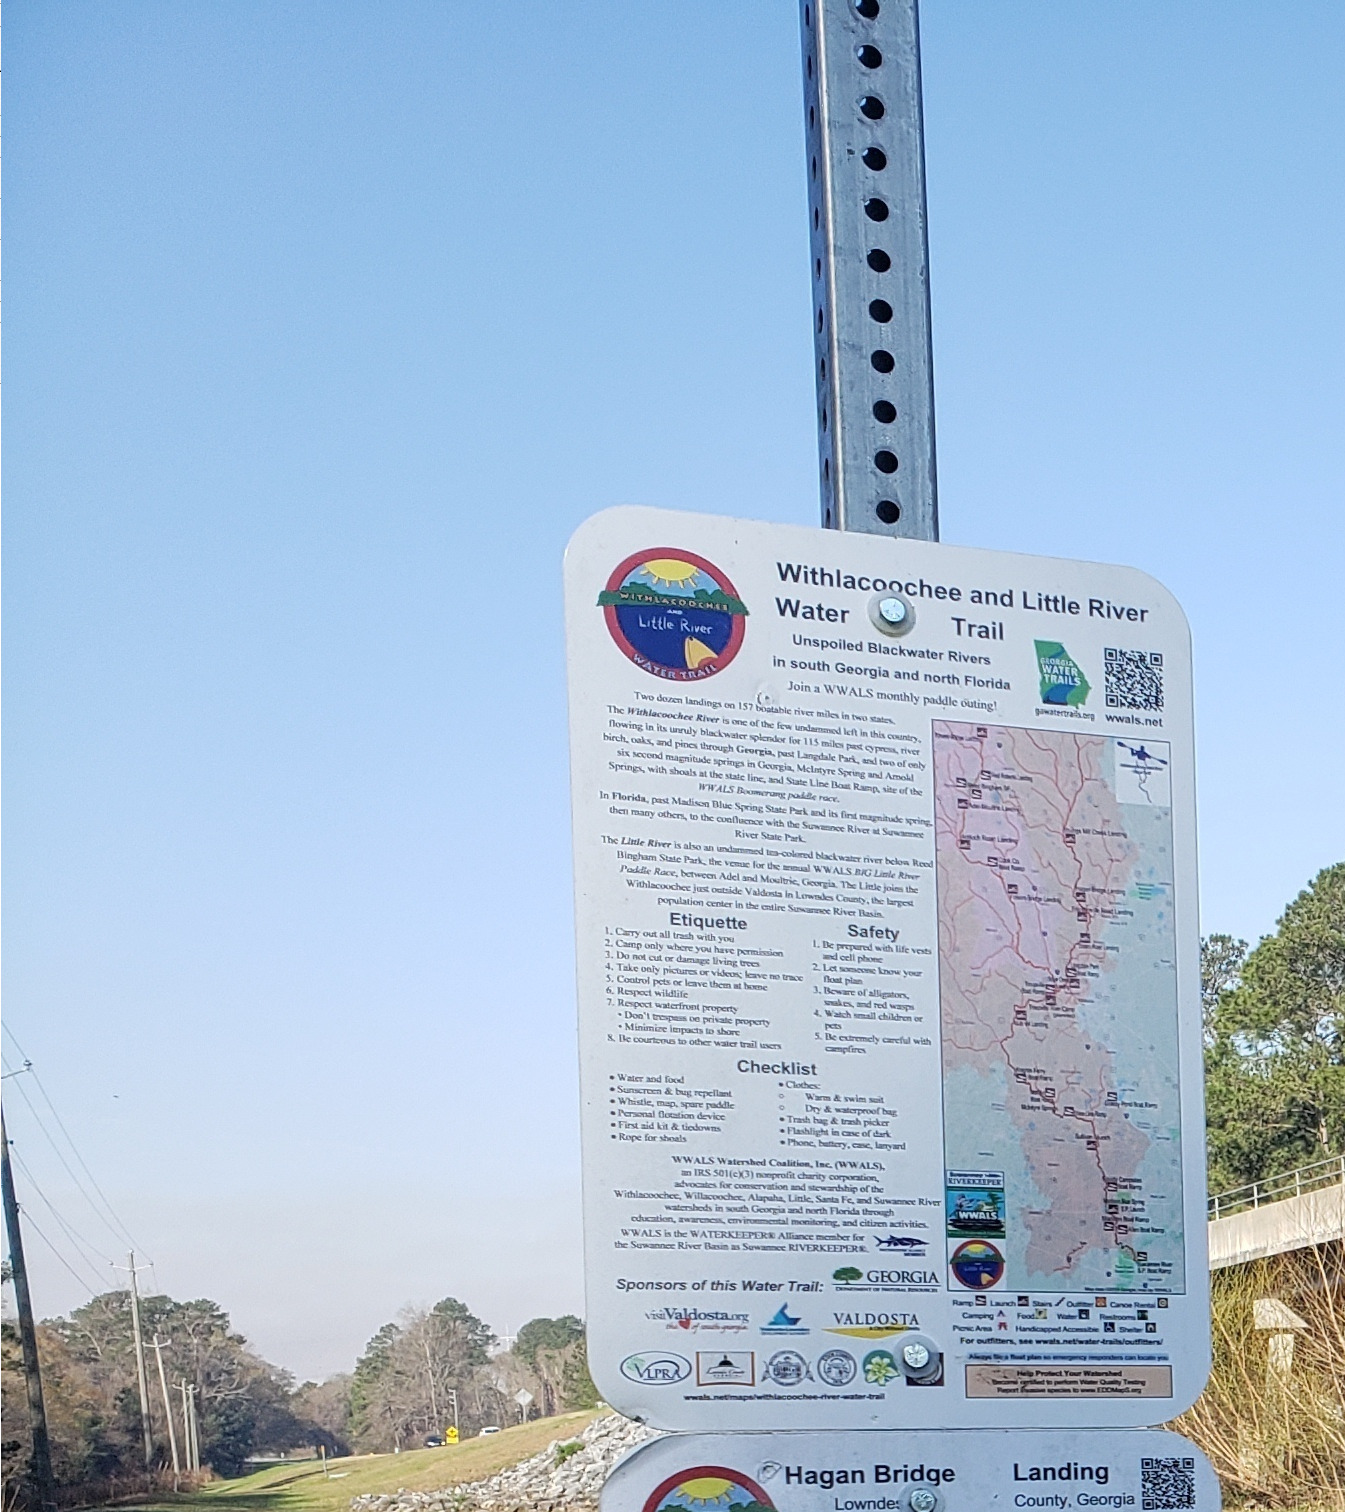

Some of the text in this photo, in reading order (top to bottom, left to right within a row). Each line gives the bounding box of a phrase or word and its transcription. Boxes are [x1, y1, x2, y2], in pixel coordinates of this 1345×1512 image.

[778, 564, 1148, 621] Withlacoochee and Little River
[620, 591, 728, 611] WITHLACOOCHEE
[639, 615, 713, 634] Little River
[776, 598, 1003, 639] Water Trail
[793, 635, 990, 664] Unspoiled Blackwater Rivers
[633, 654, 717, 679] WATER TRAIL
[1041, 658, 1073, 666] GEORGIA
[774, 656, 1010, 689] in south Georgia and north Florida
[1043, 665, 1078, 676] WATER
[1044, 675, 1081, 686] TRAILS
[788, 681, 811, 692] Join
[824, 685, 873, 697] WWALS
[877, 692, 919, 705] monthly
[924, 696, 957, 709] paddle
[961, 699, 996, 712] outing!
[634, 692, 654, 701] Two
[657, 694, 682, 703] dozen
[686, 697, 722, 709] landings
[739, 702, 753, 710] 157
[794, 708, 814, 716] river
[817, 710, 839, 718] miles
[842, 712, 849, 720] in
[1106, 714, 1163, 727] wwals.net
[670, 913, 747, 931] Etiquette
[605, 927, 613, 935] 1.
[615, 928, 640, 938] Carry
[673, 932, 694, 940] trash
[848, 924, 899, 941] Safety
[737, 1060, 817, 1076] Checklist
[618, 1074, 643, 1082] Water
[646, 1075, 661, 1083] and
[959, 1211, 997, 1219] WWALS
[617, 1279, 686, 1291] Sponsors
[692, 1280, 707, 1290] of
[711, 1280, 737, 1291] this
[742, 1281, 784, 1291] Water
[788, 1281, 823, 1292] Trail:
[867, 1271, 939, 1284] GEORGIA
[834, 1313, 919, 1325] VALDOSTA
[977, 1338, 1016, 1346] outfitters,
[785, 1463, 1109, 1490] Hagan Bridge Landing
[1015, 1494, 1071, 1509] County,
[1077, 1493, 1135, 1508] Georgia
